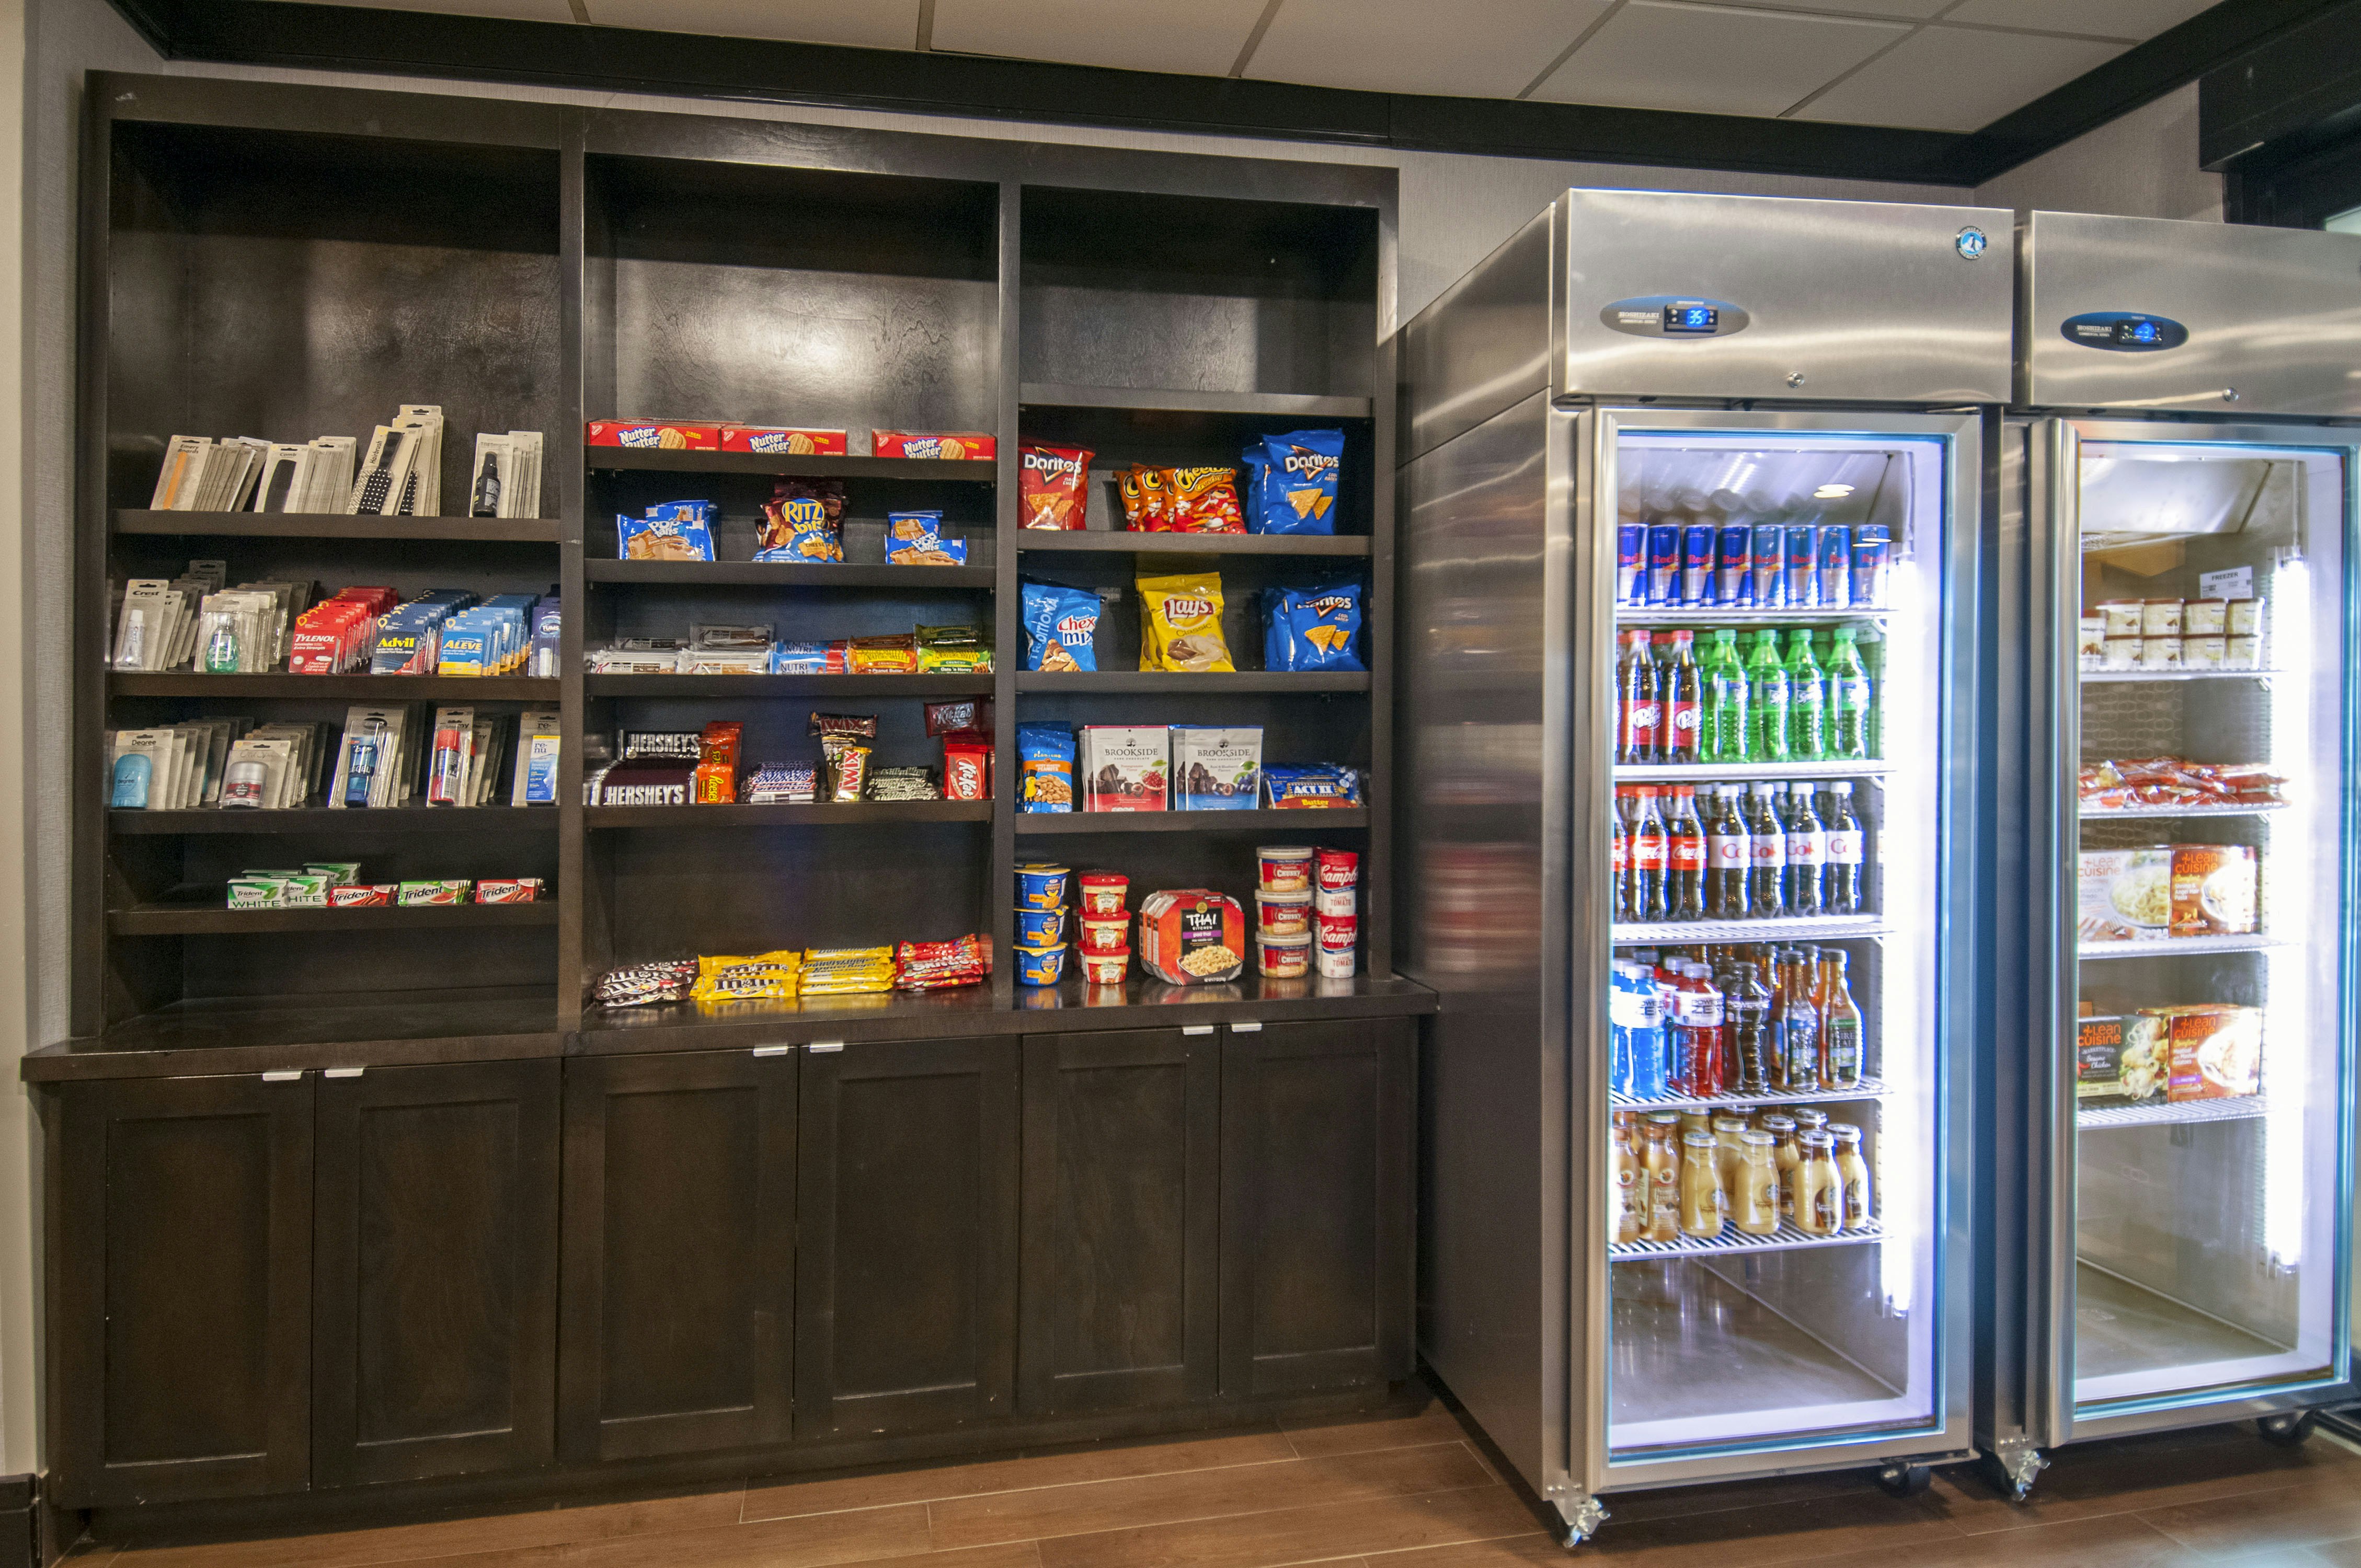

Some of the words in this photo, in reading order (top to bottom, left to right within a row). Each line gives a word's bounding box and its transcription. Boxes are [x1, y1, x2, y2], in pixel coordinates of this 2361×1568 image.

[620, 428, 656, 441] Nutter
[750, 433, 785, 448] Nutter
[371, 440, 382, 465] Hairbrush
[903, 439, 937, 454] Nutter
[1024, 453, 1082, 474] Doritos
[1285, 454, 1339, 472] Doritos
[1195, 475, 1223, 491] Crunchy
[785, 501, 822, 522] RITZ
[794, 521, 823, 534] bits
[2211, 572, 2239, 581] FREEZER
[1297, 596, 1352, 609] ritos
[1058, 617, 1096, 631] Chex
[1176, 622, 1212, 637] Classic
[295, 634, 335, 643] TYLENOL
[376, 637, 415, 648] Advil
[1064, 629, 1094, 644] mix
[443, 639, 483, 651] ALEVE
[630, 733, 700, 753] HERSHEY'S
[1105, 748, 1159, 757] BROOKSIDE
[1197, 748, 1251, 757] BROOKSIDE
[606, 785, 685, 805] HERSHEY'S
[707, 775, 724, 802] Reese's
[1294, 785, 1316, 794] ACT
[1319, 785, 1333, 794] II
[333, 890, 374, 903] Trident
[403, 885, 444, 901] Trident
[480, 883, 520, 899] Trident
[1186, 913, 1217, 927] THAI
